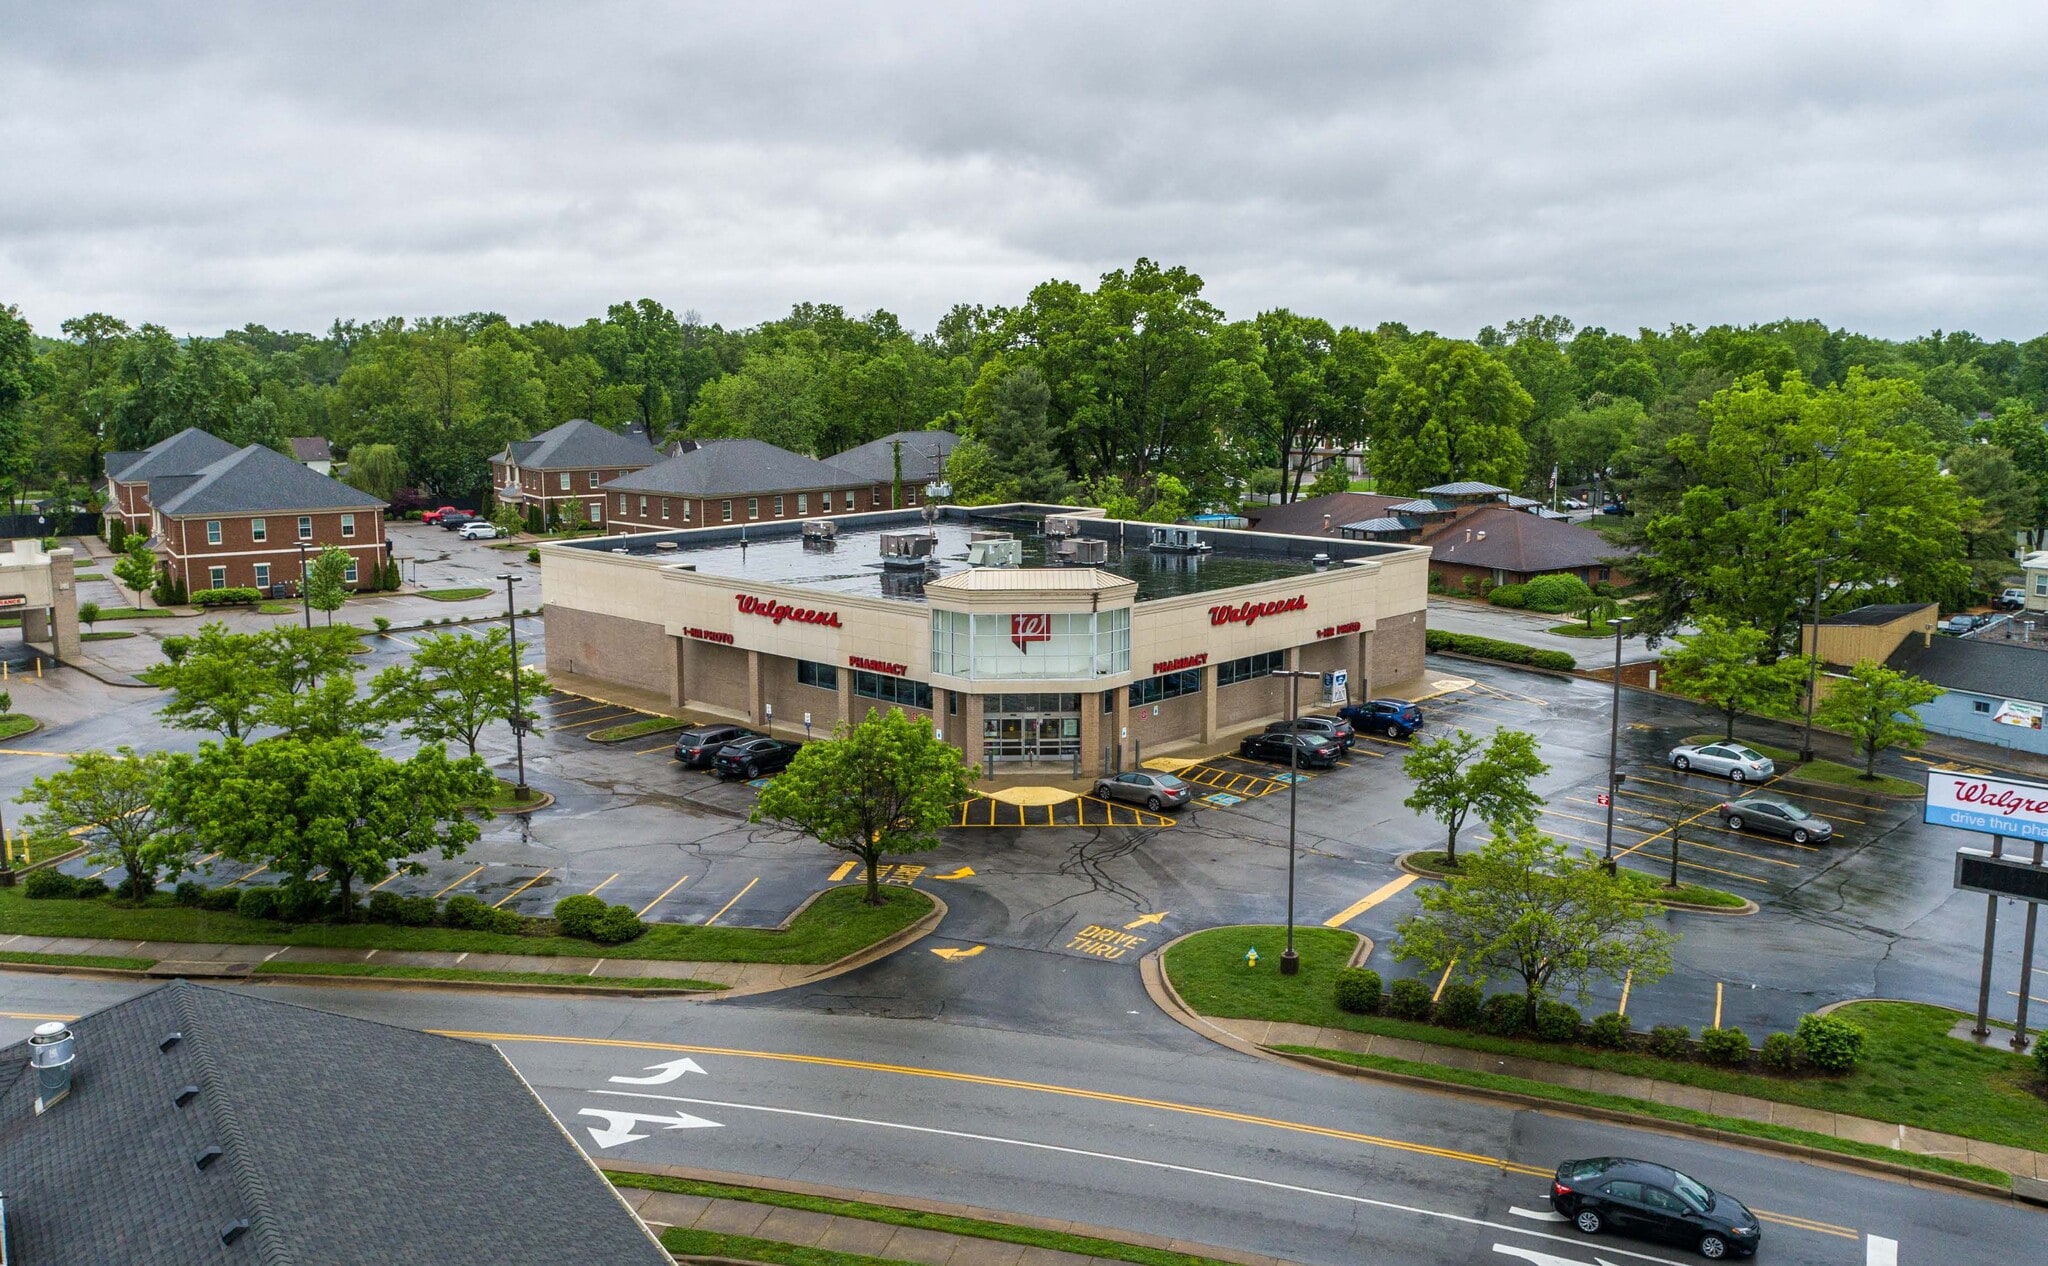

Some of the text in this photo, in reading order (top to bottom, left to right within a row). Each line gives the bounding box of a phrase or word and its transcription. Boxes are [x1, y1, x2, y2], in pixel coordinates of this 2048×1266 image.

[735, 594, 843, 628] Walgreens
[1208, 595, 1308, 626] Walgreens
[703, 630, 734, 645] PHOTO
[848, 655, 908, 677] PHARMACY
[1153, 653, 1209, 675] PHARMACY
[1954, 781, 2048, 815] Walgre
[1950, 812, 2048, 837] drive thru pha
[1065, 936, 1126, 959] THRU
[1078, 925, 1147, 949] DRIVE
